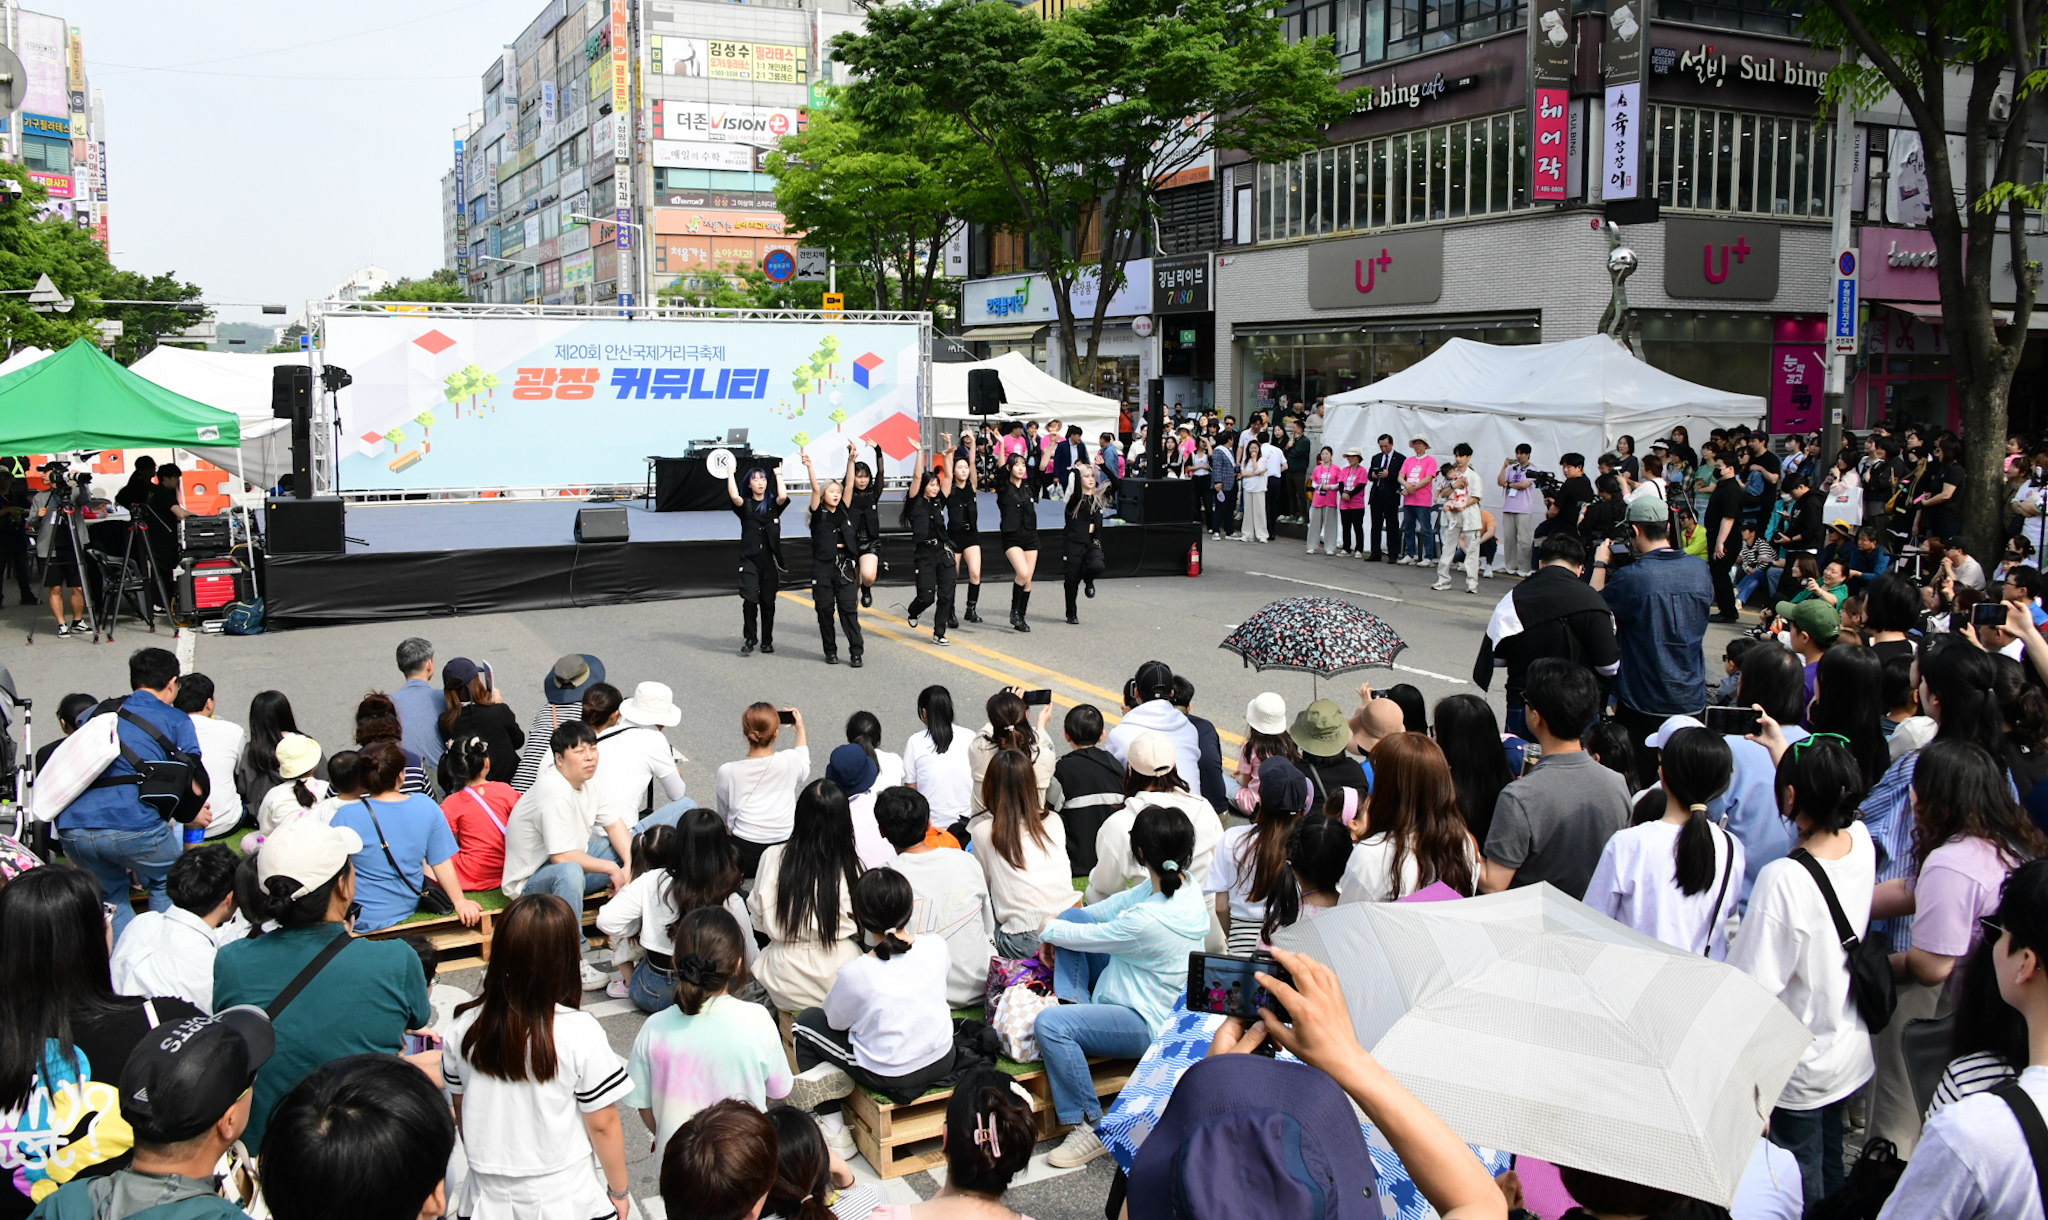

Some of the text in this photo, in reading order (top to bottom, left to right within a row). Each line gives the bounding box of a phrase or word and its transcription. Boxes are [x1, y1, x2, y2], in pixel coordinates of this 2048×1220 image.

[710, 43, 750, 58] 김성수
[755, 46, 794, 61] 필라테스
[1654, 48, 1676, 58] KOREAN
[1651, 56, 1675, 66] DESSERT
[1680, 43, 1727, 88] 설빙
[1740, 54, 1776, 82] Sul
[1654, 65, 1669, 74] CAFE
[616, 64, 626, 100] 골프존
[1379, 73, 1420, 108] bing
[1421, 72, 1445, 100] cafe
[24, 118, 70, 134] 기구필라테스
[677, 111, 766, 132] 더존 VISION
[1569, 113, 1577, 156] SULBING
[701, 152, 721, 162] 수학
[670, 246, 708, 262] 처음가는
[714, 249, 754, 259] 소아치과
[799, 251, 825, 259] 견인지역
[1704, 236, 1751, 284] U+
[1355, 248, 1393, 293] U+
[1167, 289, 1193, 305] 7080
[554, 344, 726, 361] 제20회 안산국제거리극축제
[512, 367, 770, 401] 광장 커뮤니티
